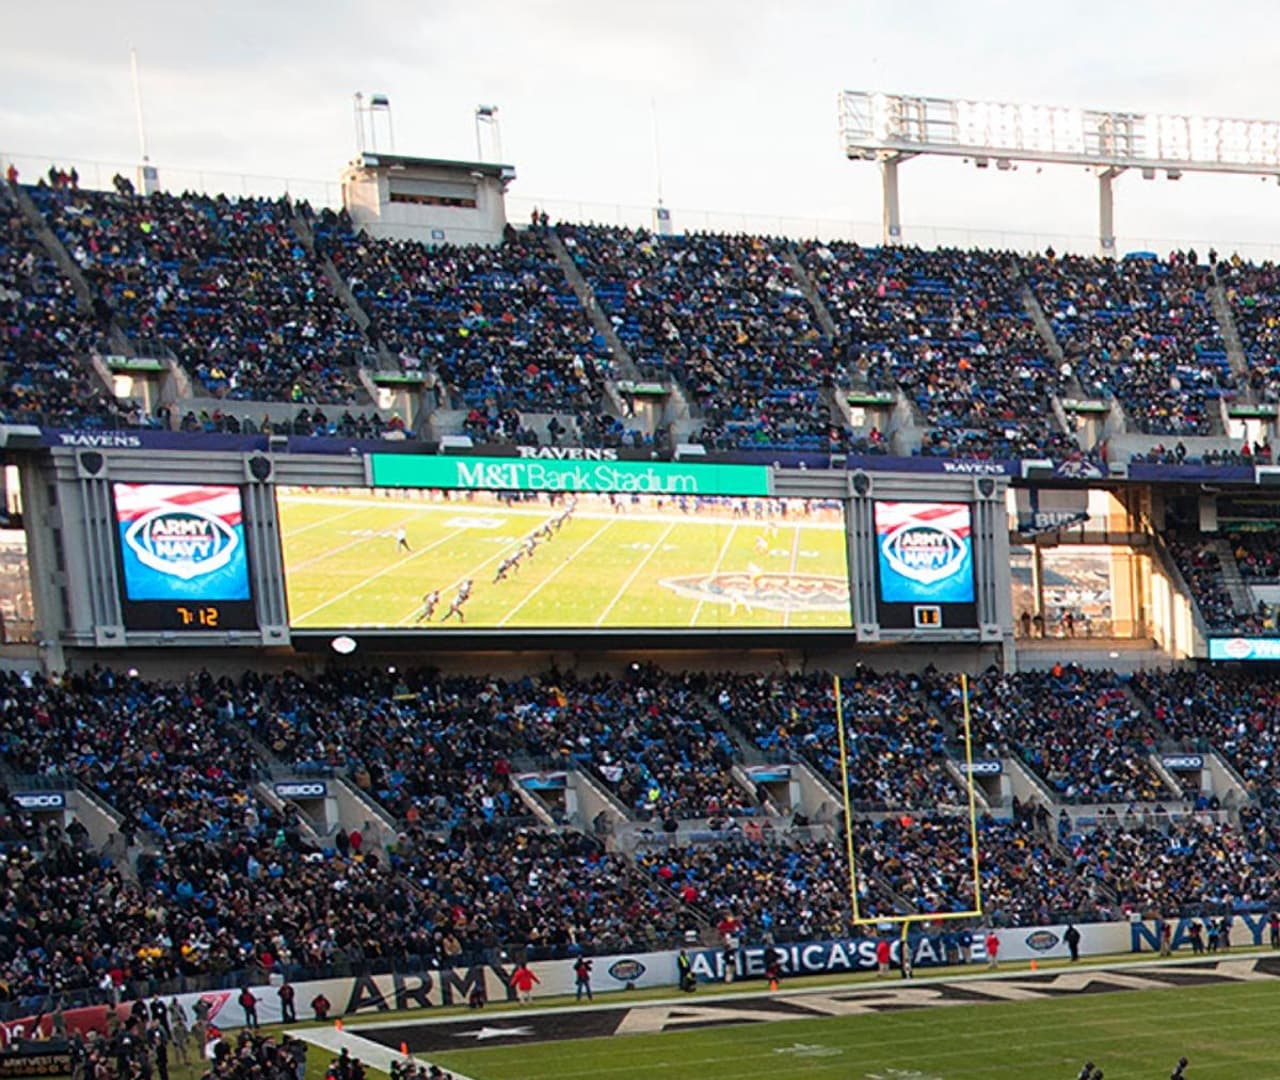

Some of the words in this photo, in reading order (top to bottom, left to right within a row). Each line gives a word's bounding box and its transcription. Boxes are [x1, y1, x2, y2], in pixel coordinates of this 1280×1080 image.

[59, 433, 142, 448] RAVENS
[515, 445, 619, 461] RAVENS
[943, 462, 1005, 474] RAVENS
[455, 461, 526, 489] M&T
[527, 463, 591, 491] Bank
[593, 465, 699, 493] Stadium
[152, 519, 210, 536] ARMY
[901, 532, 945, 547] ARMY
[155, 541, 210, 558] NAVY
[904, 551, 945, 566] NAVY
